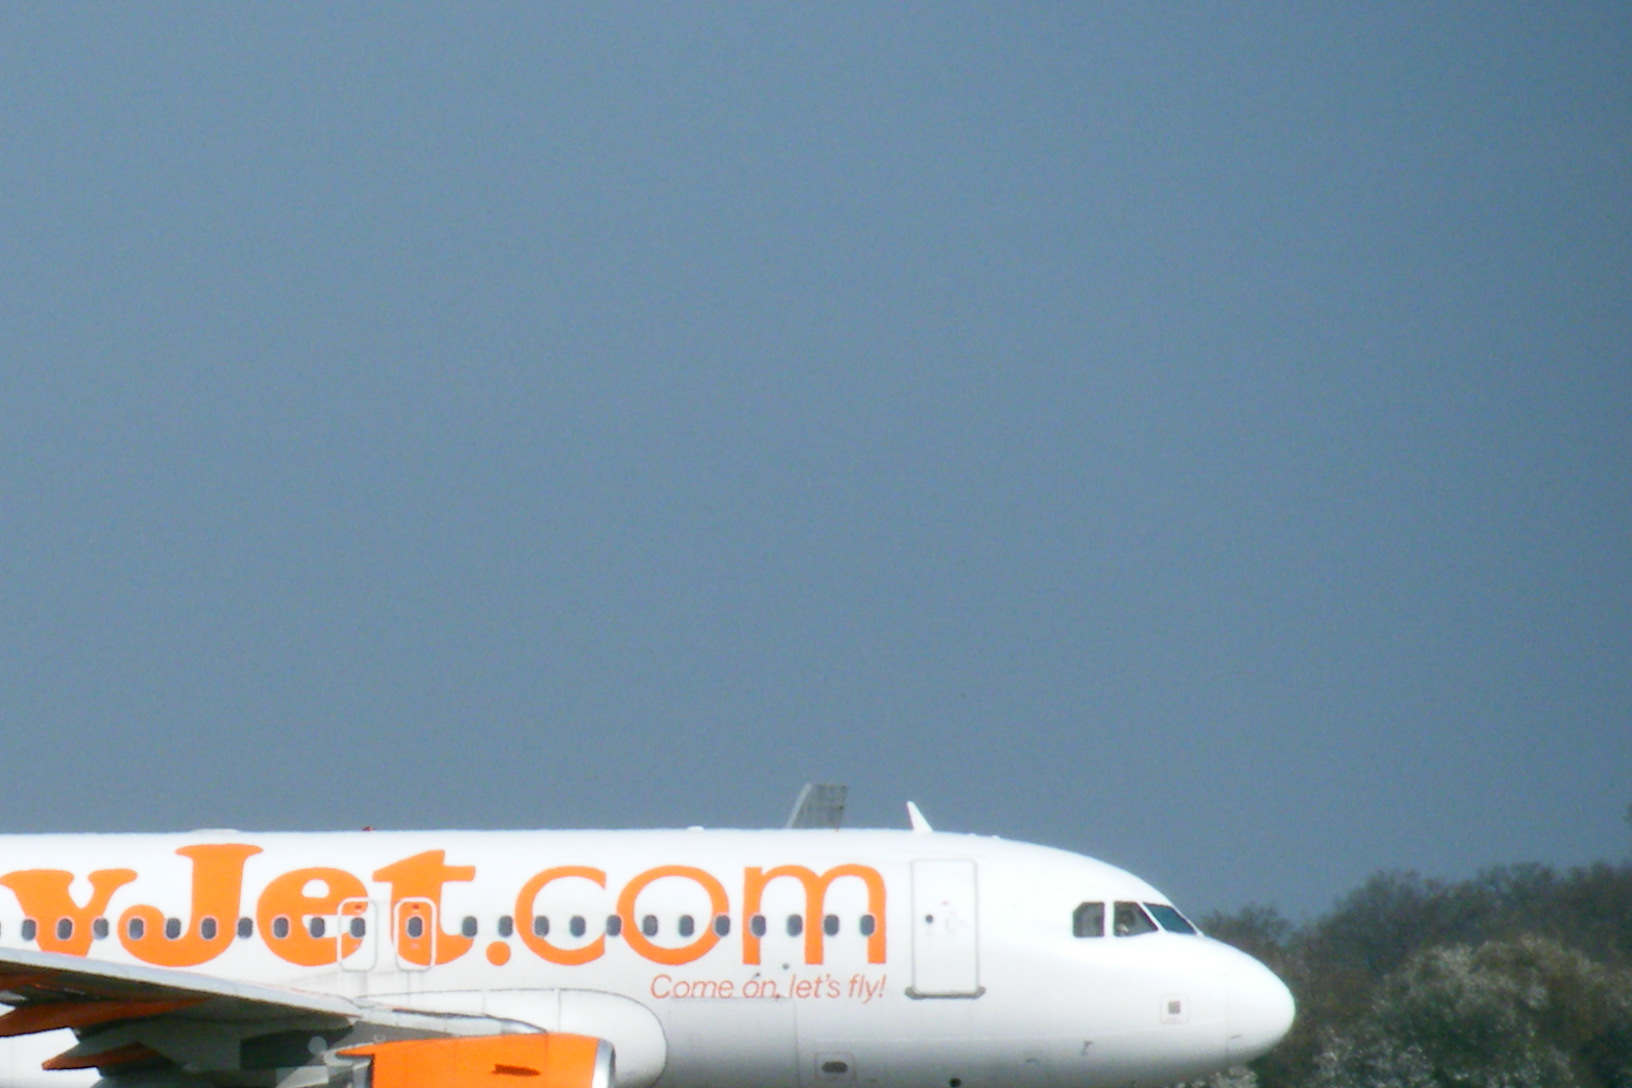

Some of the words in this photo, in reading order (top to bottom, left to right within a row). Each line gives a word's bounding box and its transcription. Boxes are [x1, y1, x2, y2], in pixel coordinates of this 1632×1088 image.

[649, 973, 734, 999] Come
[742, 977, 782, 1001] on,
[788, 973, 841, 999] let's
[848, 974, 888, 1004] fly!
